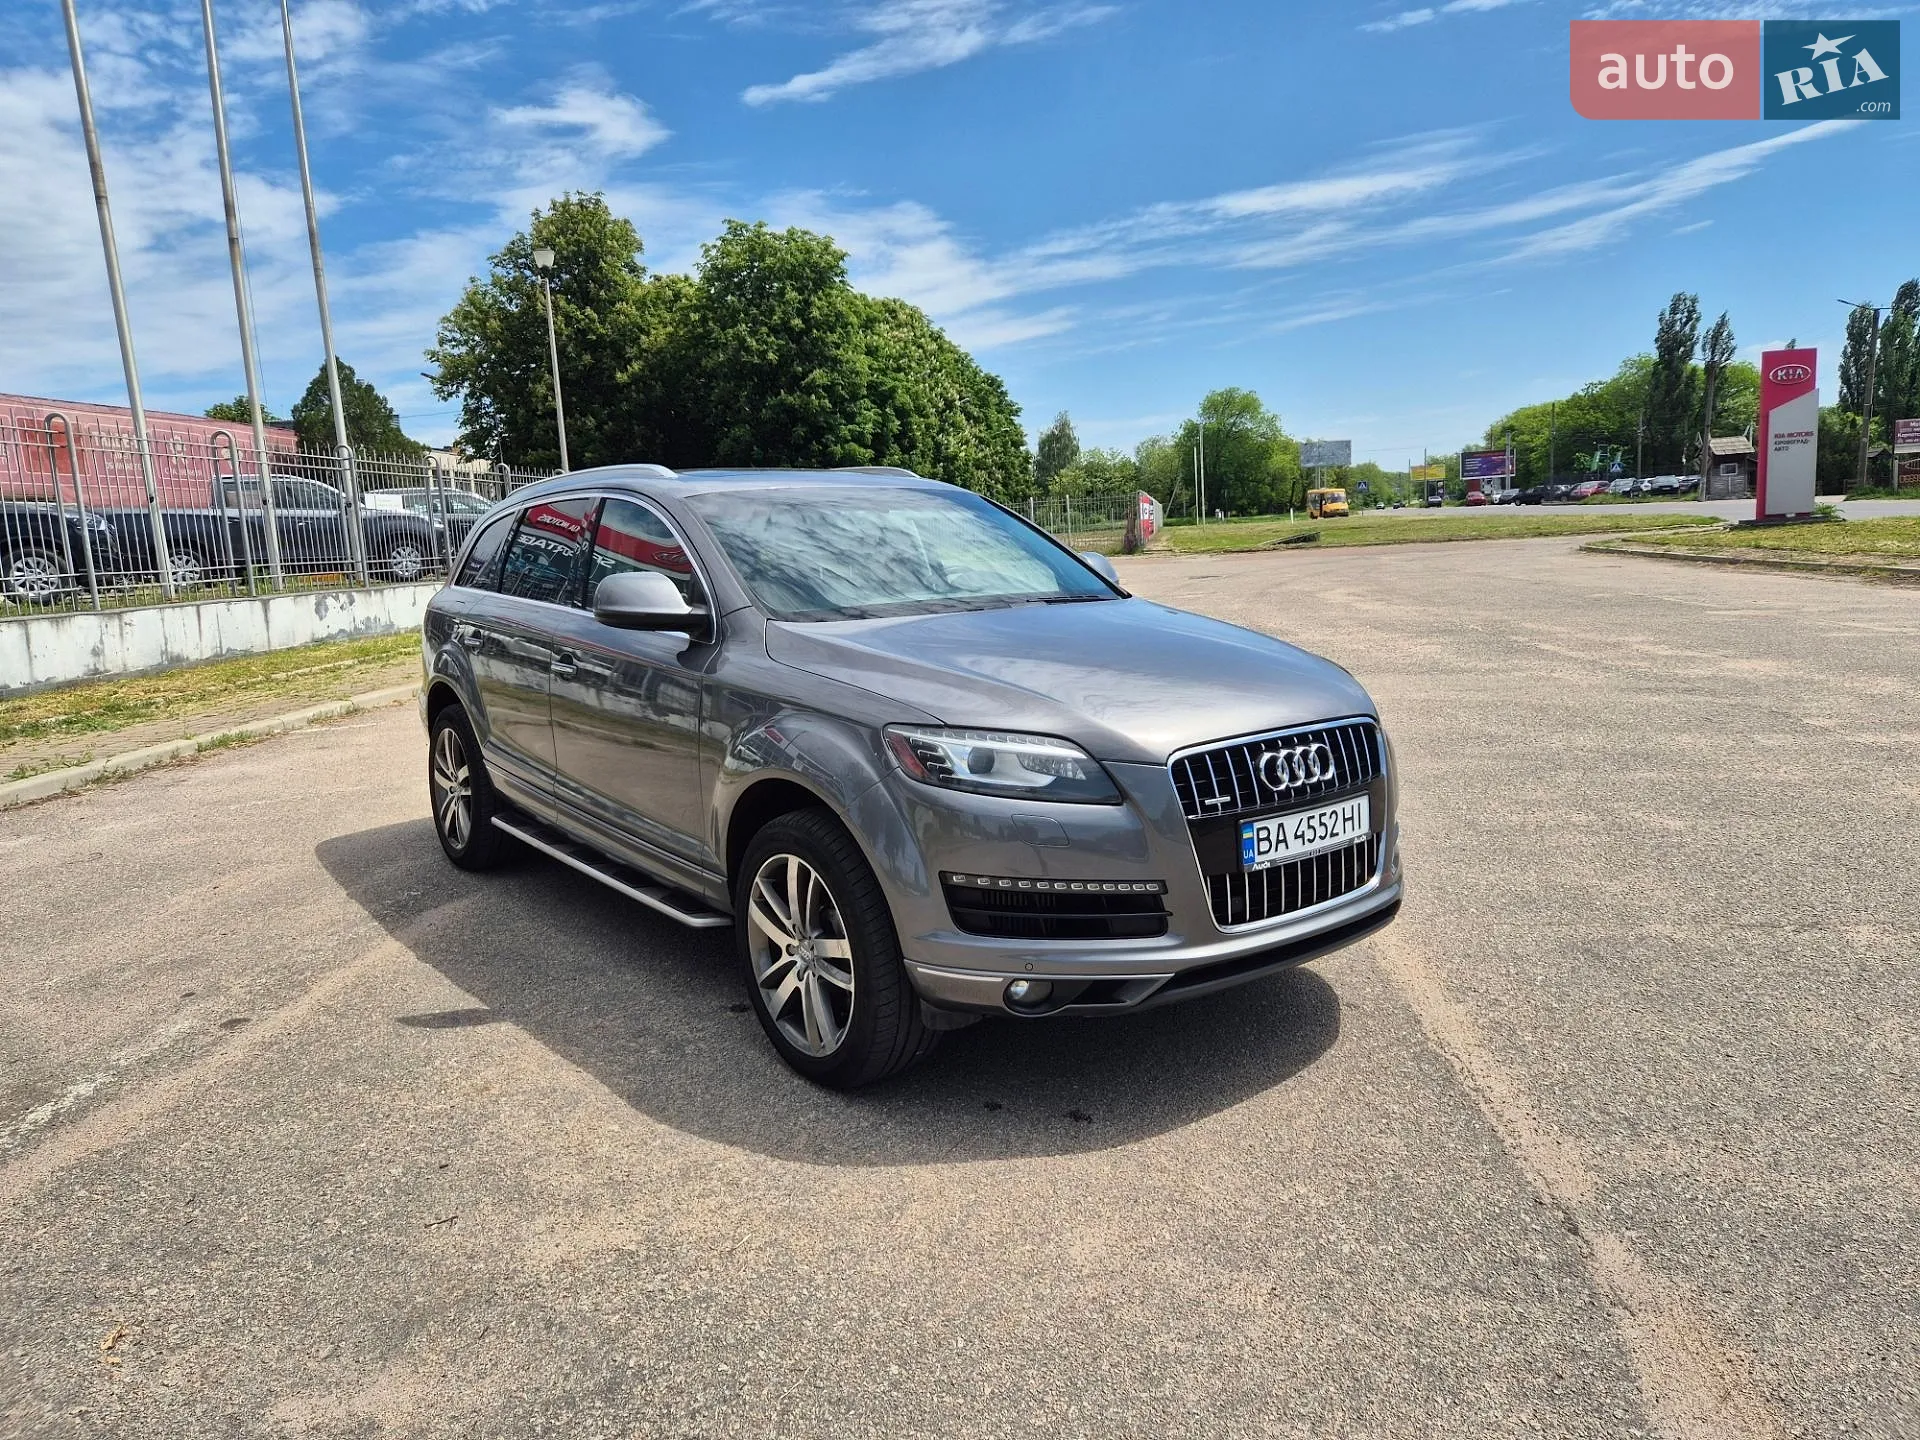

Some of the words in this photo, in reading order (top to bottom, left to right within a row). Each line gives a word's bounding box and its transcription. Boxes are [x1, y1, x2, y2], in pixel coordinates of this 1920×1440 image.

[1777, 368, 1804, 381] KIA
[1256, 821, 1289, 856] BA
[1293, 809, 1340, 846] 4552
[1243, 850, 1254, 859] UA
[1252, 861, 1271, 871] Audi
